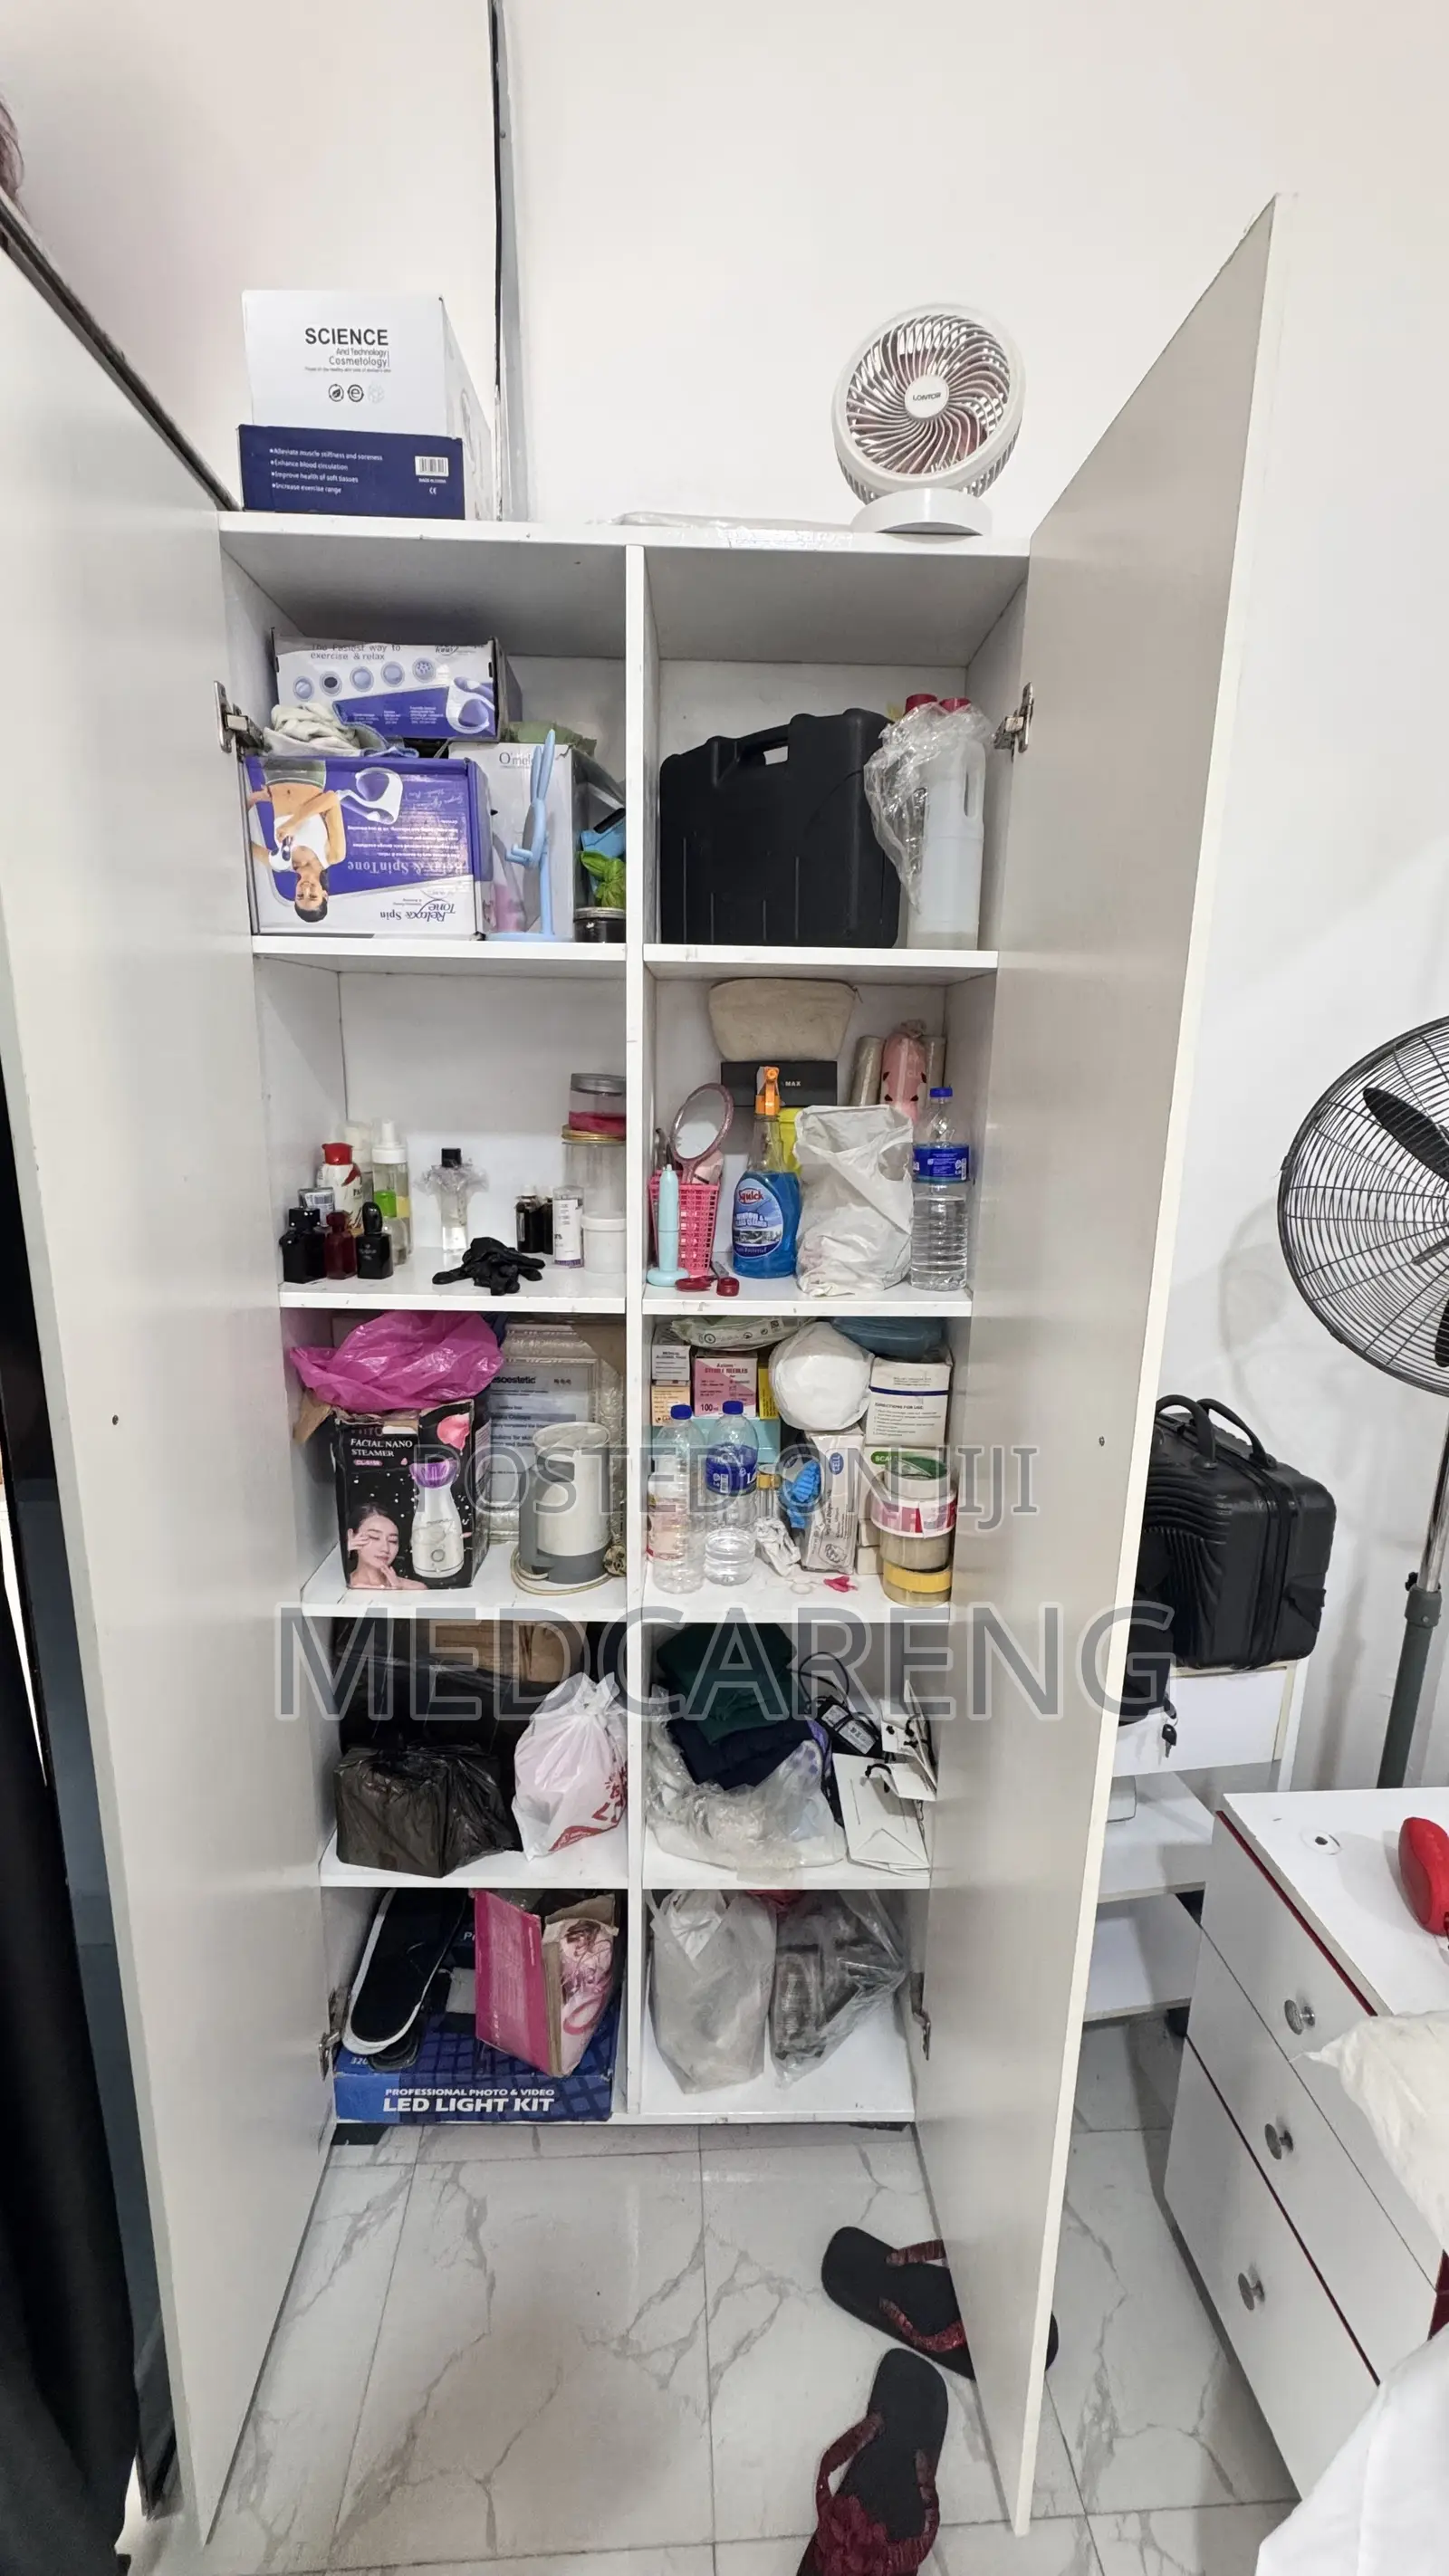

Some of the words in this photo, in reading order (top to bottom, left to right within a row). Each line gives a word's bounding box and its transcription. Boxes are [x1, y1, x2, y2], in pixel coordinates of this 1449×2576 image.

[305, 328, 389, 345] SCIENCE
[336, 348, 350, 356] And
[350, 348, 386, 358] Technology
[329, 355, 387, 368] Cosmetology
[369, 644, 388, 653] way
[391, 643, 401, 652] to
[311, 652, 349, 660] exercise
[362, 652, 385, 660] relax
[380, 909, 402, 920] Spin
[427, 903, 456, 915] Tone
[412, 911, 446, 923] Relax
[492, 1375, 536, 1384] esoestetic
[701, 1403, 714, 1412] 100
[350, 1438, 383, 1448] FACIAL
[385, 1440, 413, 1449] NANO
[351, 1449, 395, 1457] STEAMER
[832, 1455, 840, 1472] CELL
[385, 2088, 467, 2096] PROFESSIONAL
[469, 2088, 508, 2096] PHOTO
[383, 2098, 430, 2112] LED
[435, 2098, 509, 2112] LIGHT
[513, 2098, 555, 2112] KIT
